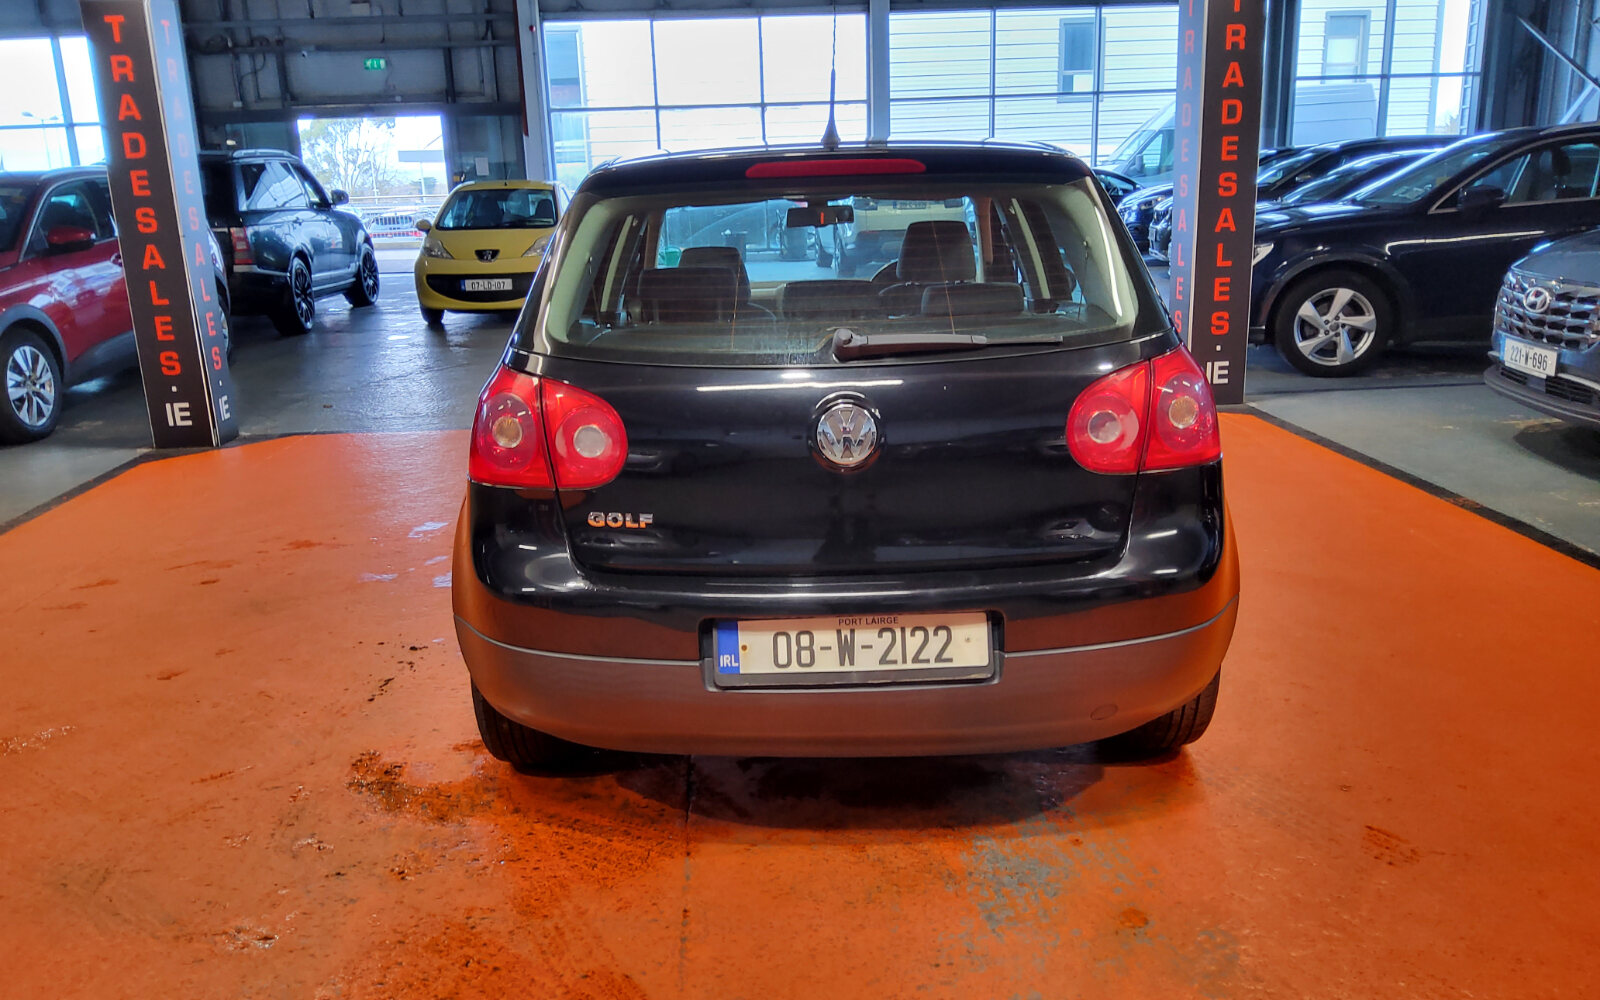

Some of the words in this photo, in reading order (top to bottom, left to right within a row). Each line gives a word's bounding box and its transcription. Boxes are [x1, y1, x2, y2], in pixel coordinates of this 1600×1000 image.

[1510, 345, 1548, 371] 221-W-696
[587, 511, 653, 528] GOLF
[838, 617, 863, 626] PORT
[772, 625, 954, 669] 08-W-2122
[720, 653, 739, 668] IRL
